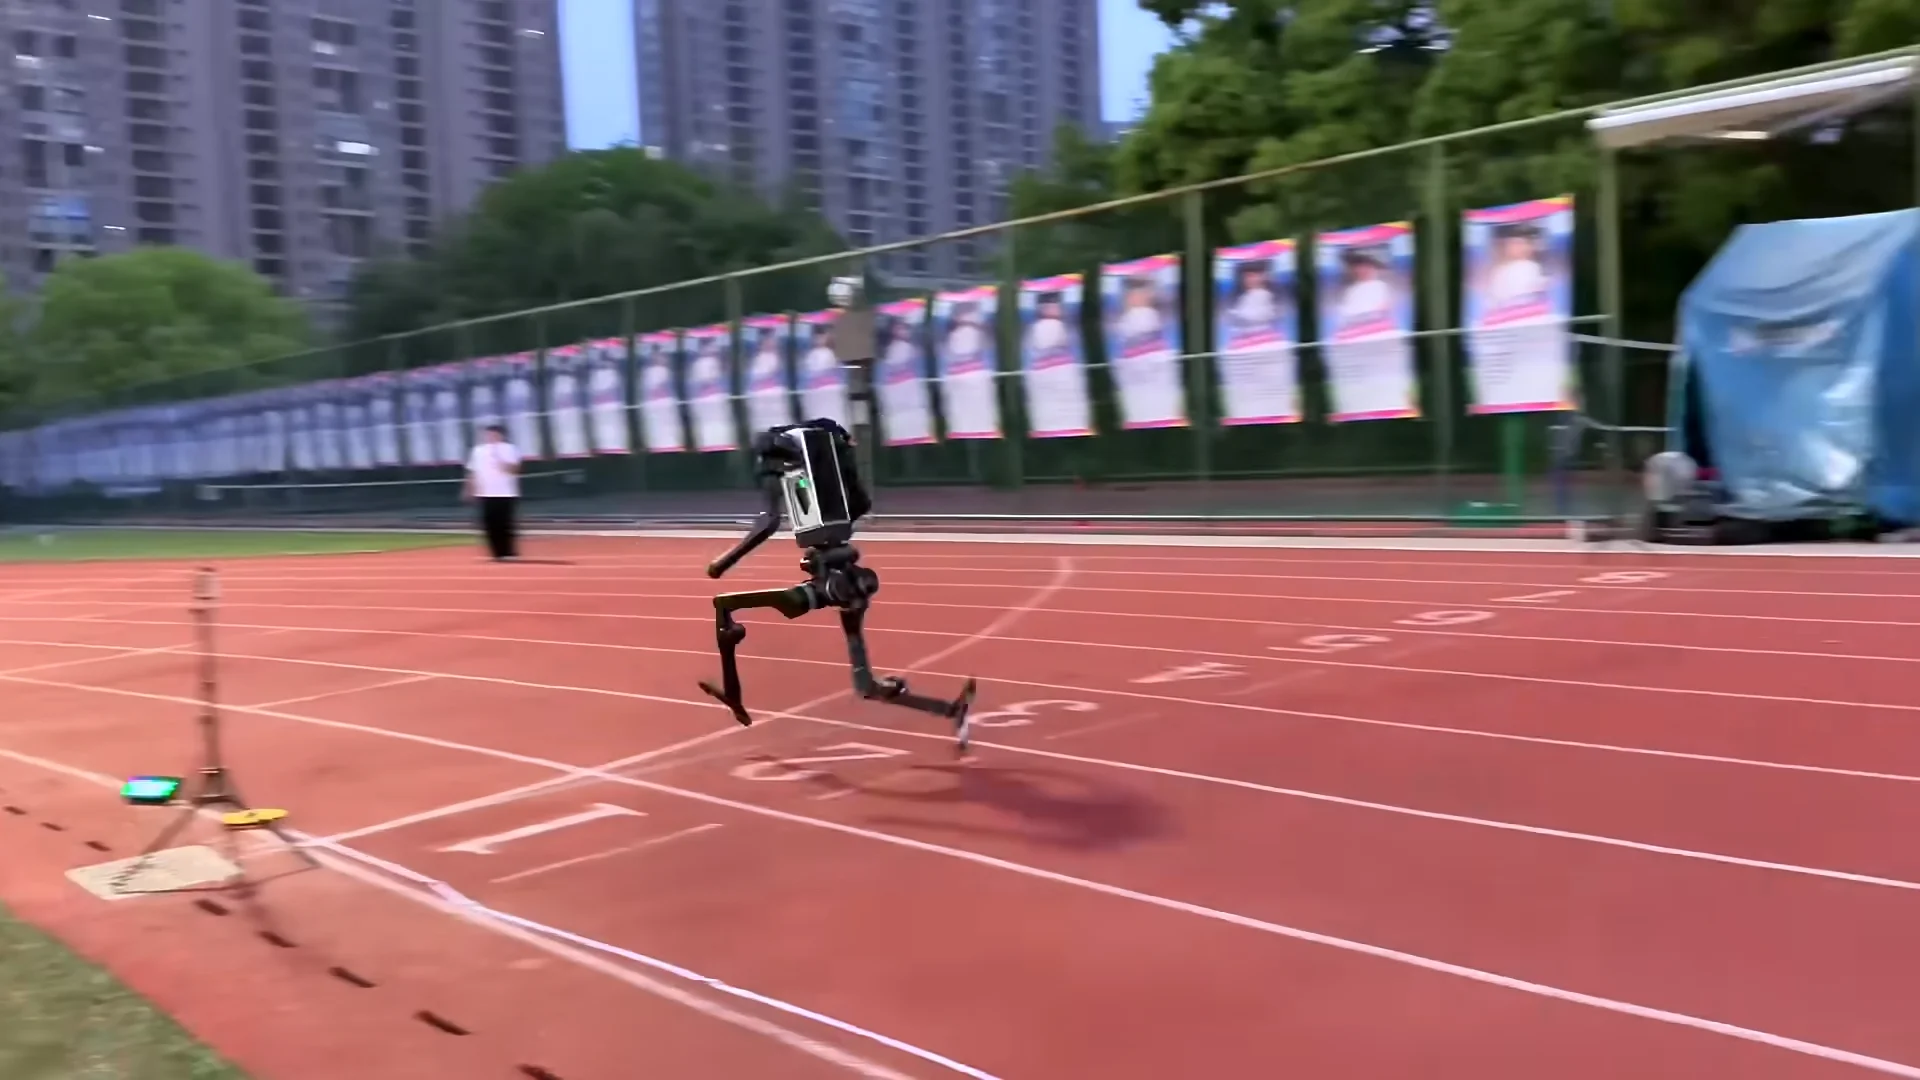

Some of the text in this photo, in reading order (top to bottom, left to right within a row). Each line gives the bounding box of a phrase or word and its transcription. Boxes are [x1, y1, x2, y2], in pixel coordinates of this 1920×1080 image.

[1489, 590, 1579, 602] 7
[1266, 634, 1391, 653] 5
[1128, 661, 1246, 683] 4
[967, 699, 1098, 727] 3
[729, 742, 912, 781] 2
[436, 802, 648, 854] 1
